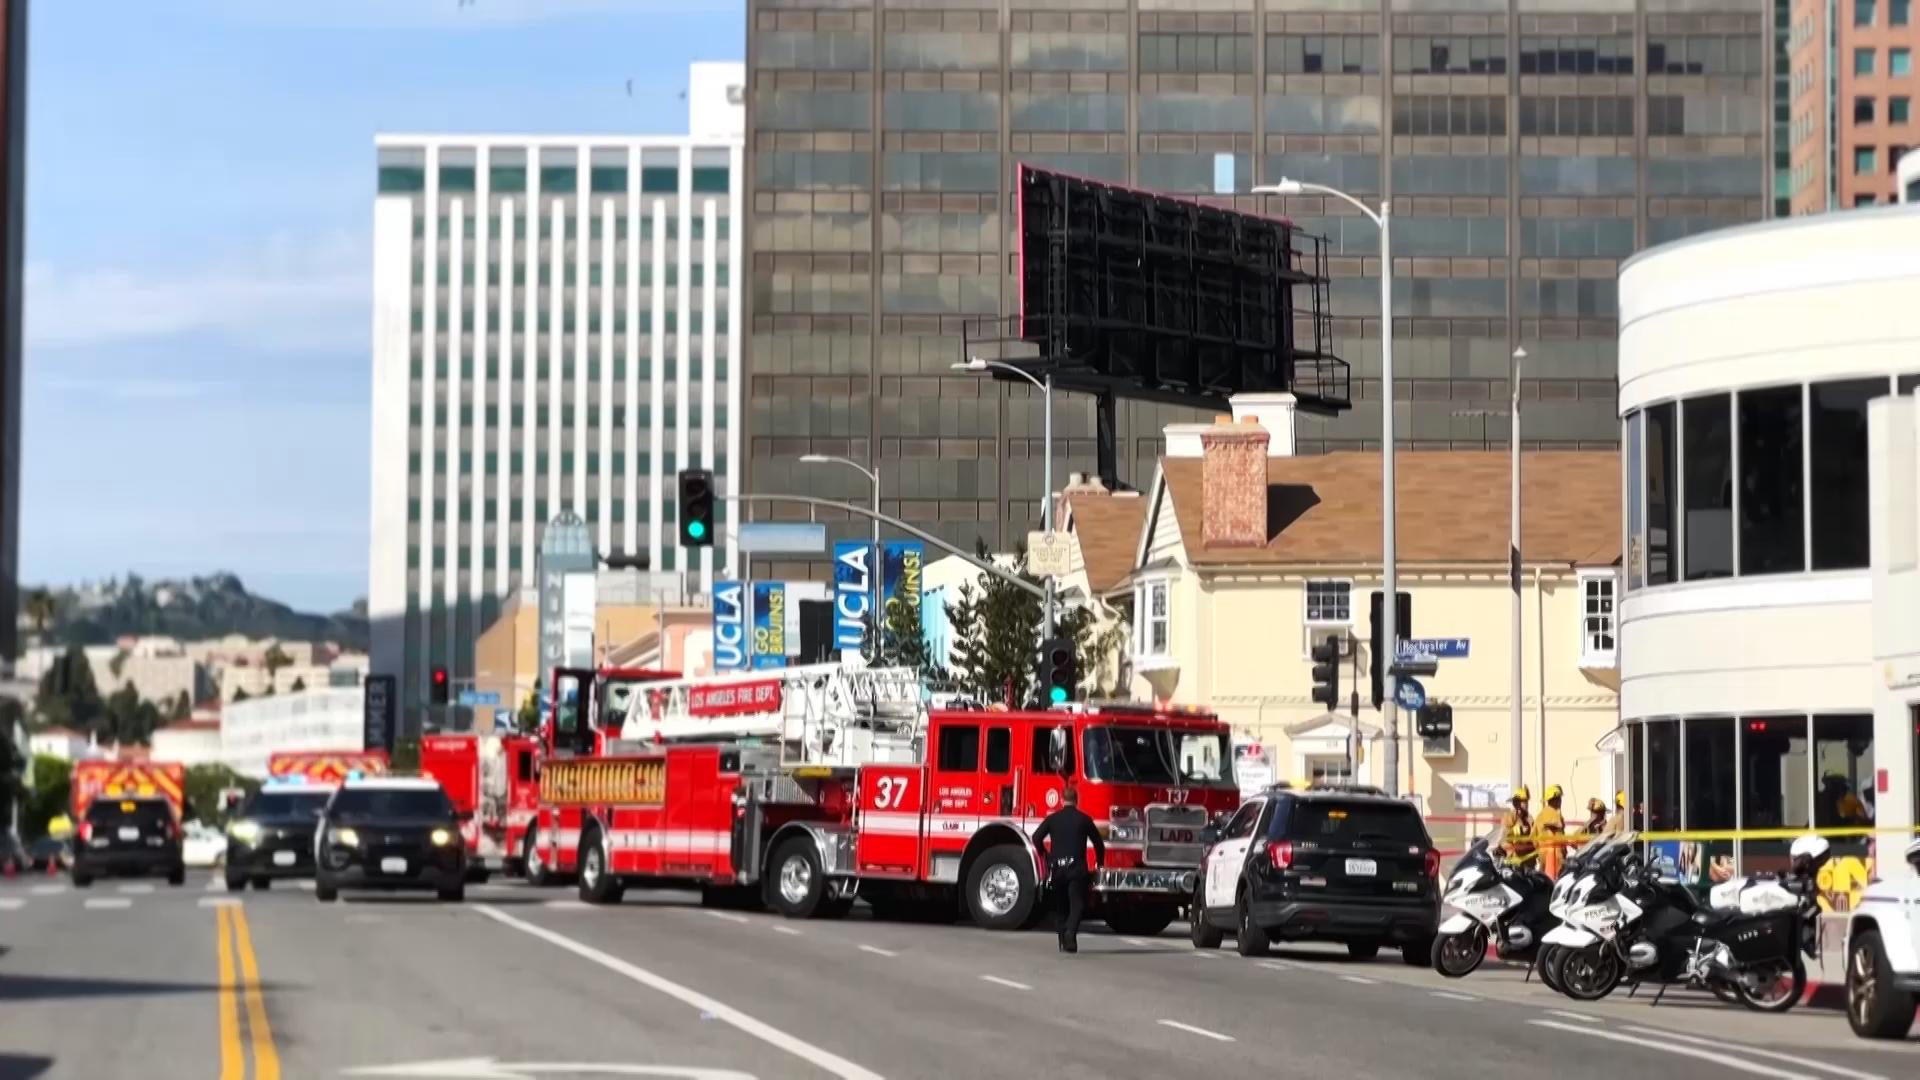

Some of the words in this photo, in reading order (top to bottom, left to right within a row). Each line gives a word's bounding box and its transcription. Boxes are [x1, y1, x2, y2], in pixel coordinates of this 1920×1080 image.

[838, 545, 868, 649] UCLA
[716, 585, 742, 666] UCLA
[769, 588, 784, 655] BRUINS!
[755, 626, 769, 655] GO
[874, 776, 908, 809] 37
[1166, 788, 1190, 804] T37
[1159, 829, 1193, 843] LAFD
